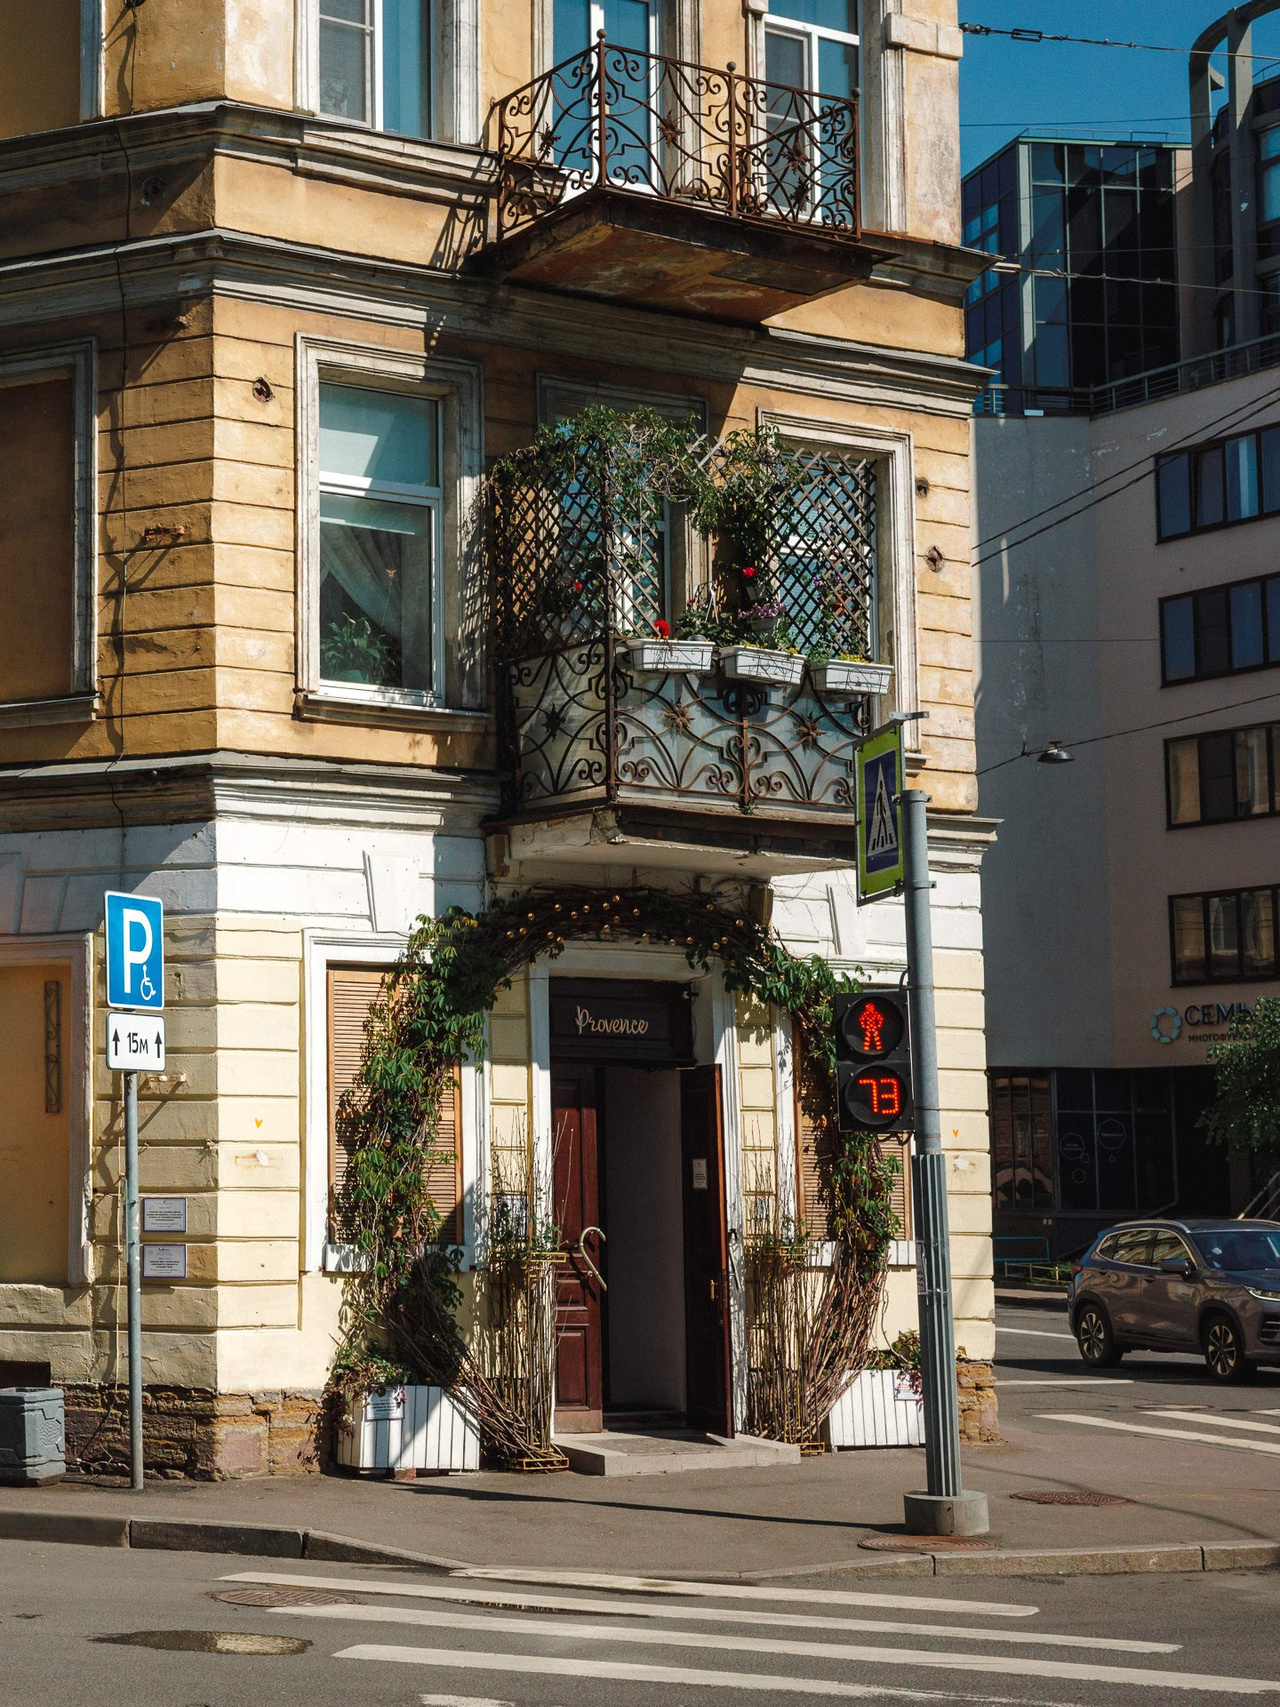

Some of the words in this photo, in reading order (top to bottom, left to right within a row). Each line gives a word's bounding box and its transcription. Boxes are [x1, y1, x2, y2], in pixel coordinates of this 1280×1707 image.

[123, 908, 153, 994] P
[575, 1005, 649, 1034] Provence
[858, 1078, 899, 1115] 73
